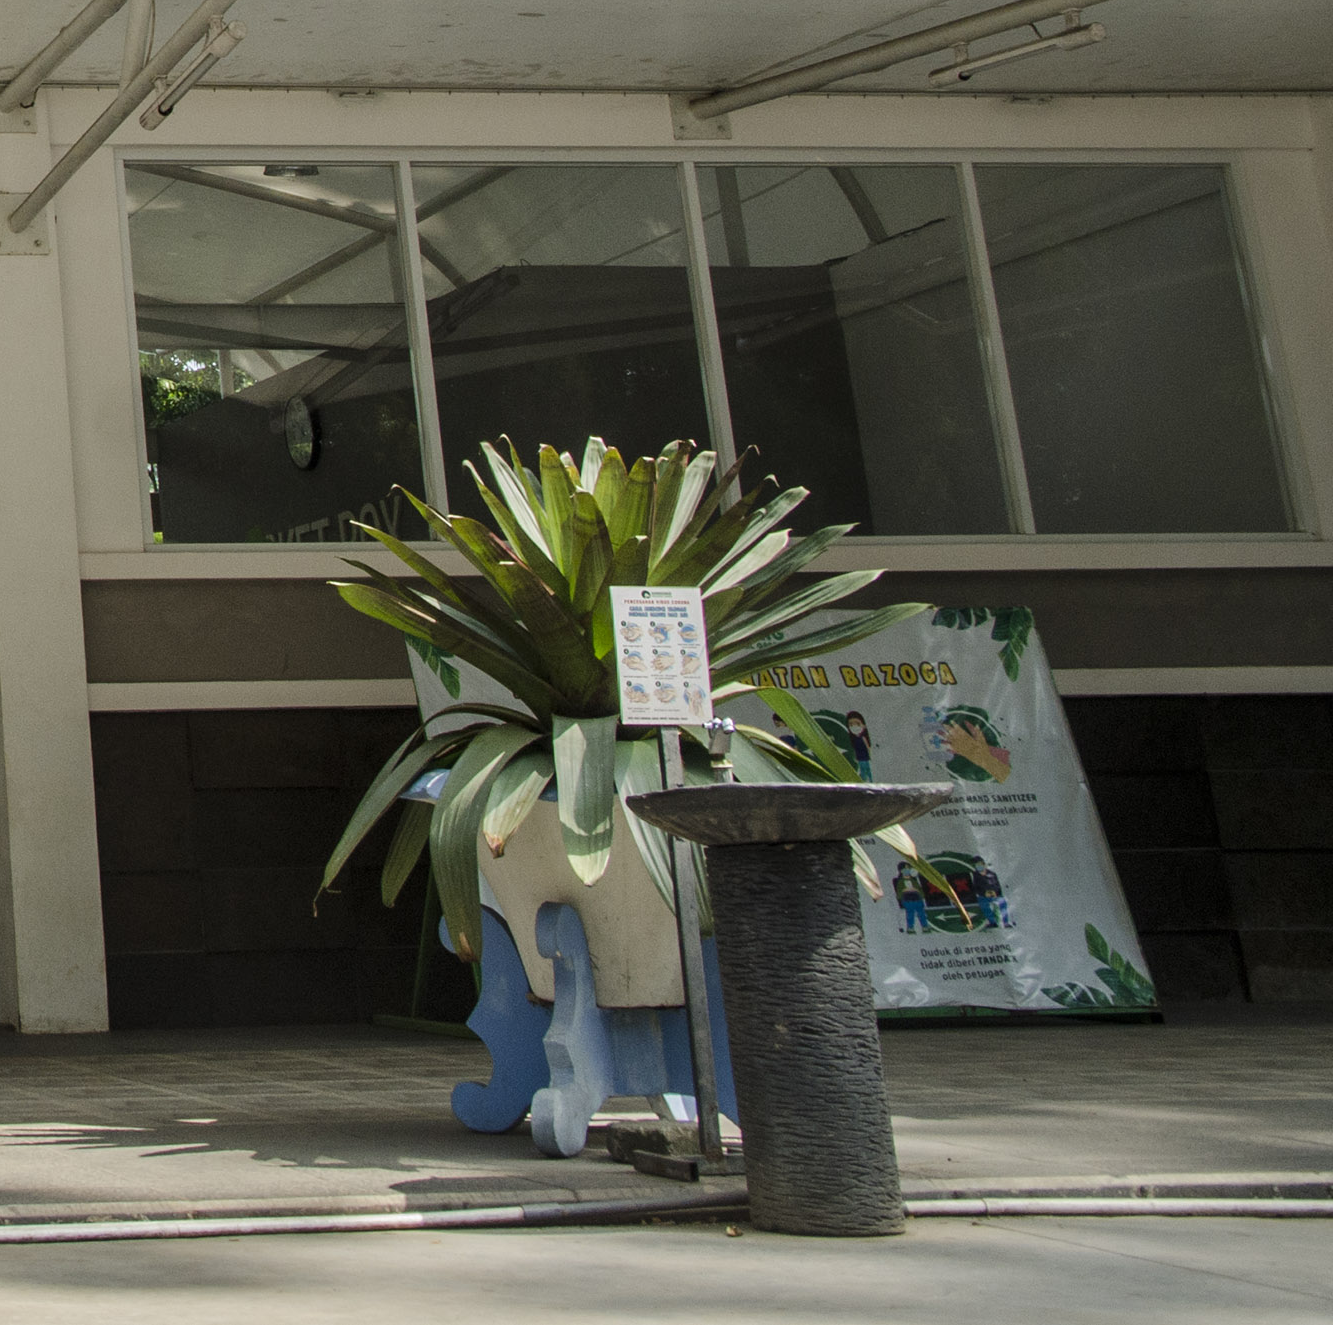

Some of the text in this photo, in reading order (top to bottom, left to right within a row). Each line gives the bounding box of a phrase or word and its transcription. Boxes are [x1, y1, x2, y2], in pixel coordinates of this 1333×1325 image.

[992, 793, 1038, 803] SANITIZER
[930, 808, 960, 818] setiap
[920, 943, 1012, 957] Duduk di area yang
[920, 960, 945, 969] tidak
[947, 957, 976, 968] diberi
[976, 955, 1011, 966] TANDA
[942, 968, 1006, 981] oleh petugas
